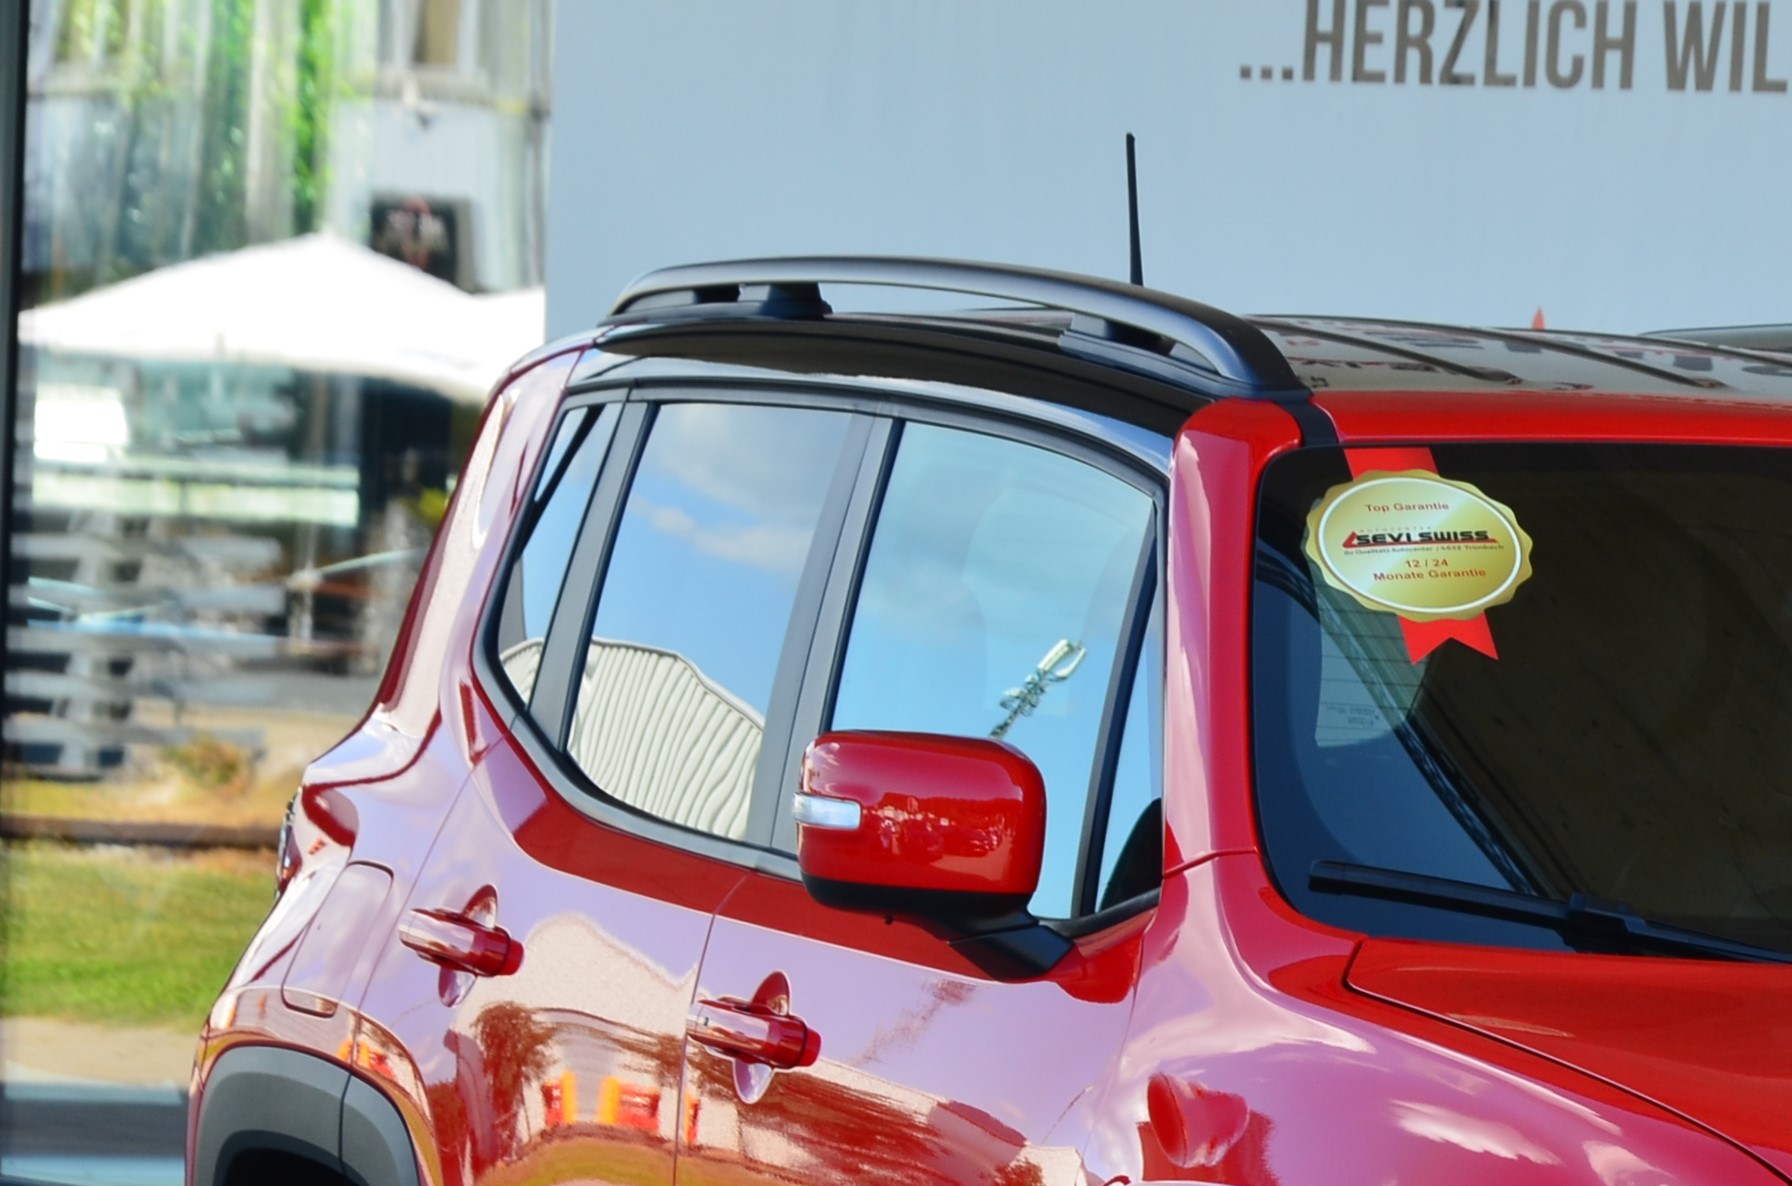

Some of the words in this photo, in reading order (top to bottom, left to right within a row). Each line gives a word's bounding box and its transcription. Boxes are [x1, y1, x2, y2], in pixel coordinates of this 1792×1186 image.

[1365, 504, 1389, 513] Top
[1394, 502, 1449, 512] Garantie
[1355, 532, 1413, 546] SEVI
[1418, 530, 1489, 544] SWISS
[1406, 560, 1421, 568] 12
[1433, 559, 1448, 568] 24
[1373, 571, 1424, 582] Monate
[1428, 569, 1487, 579] Garantie
